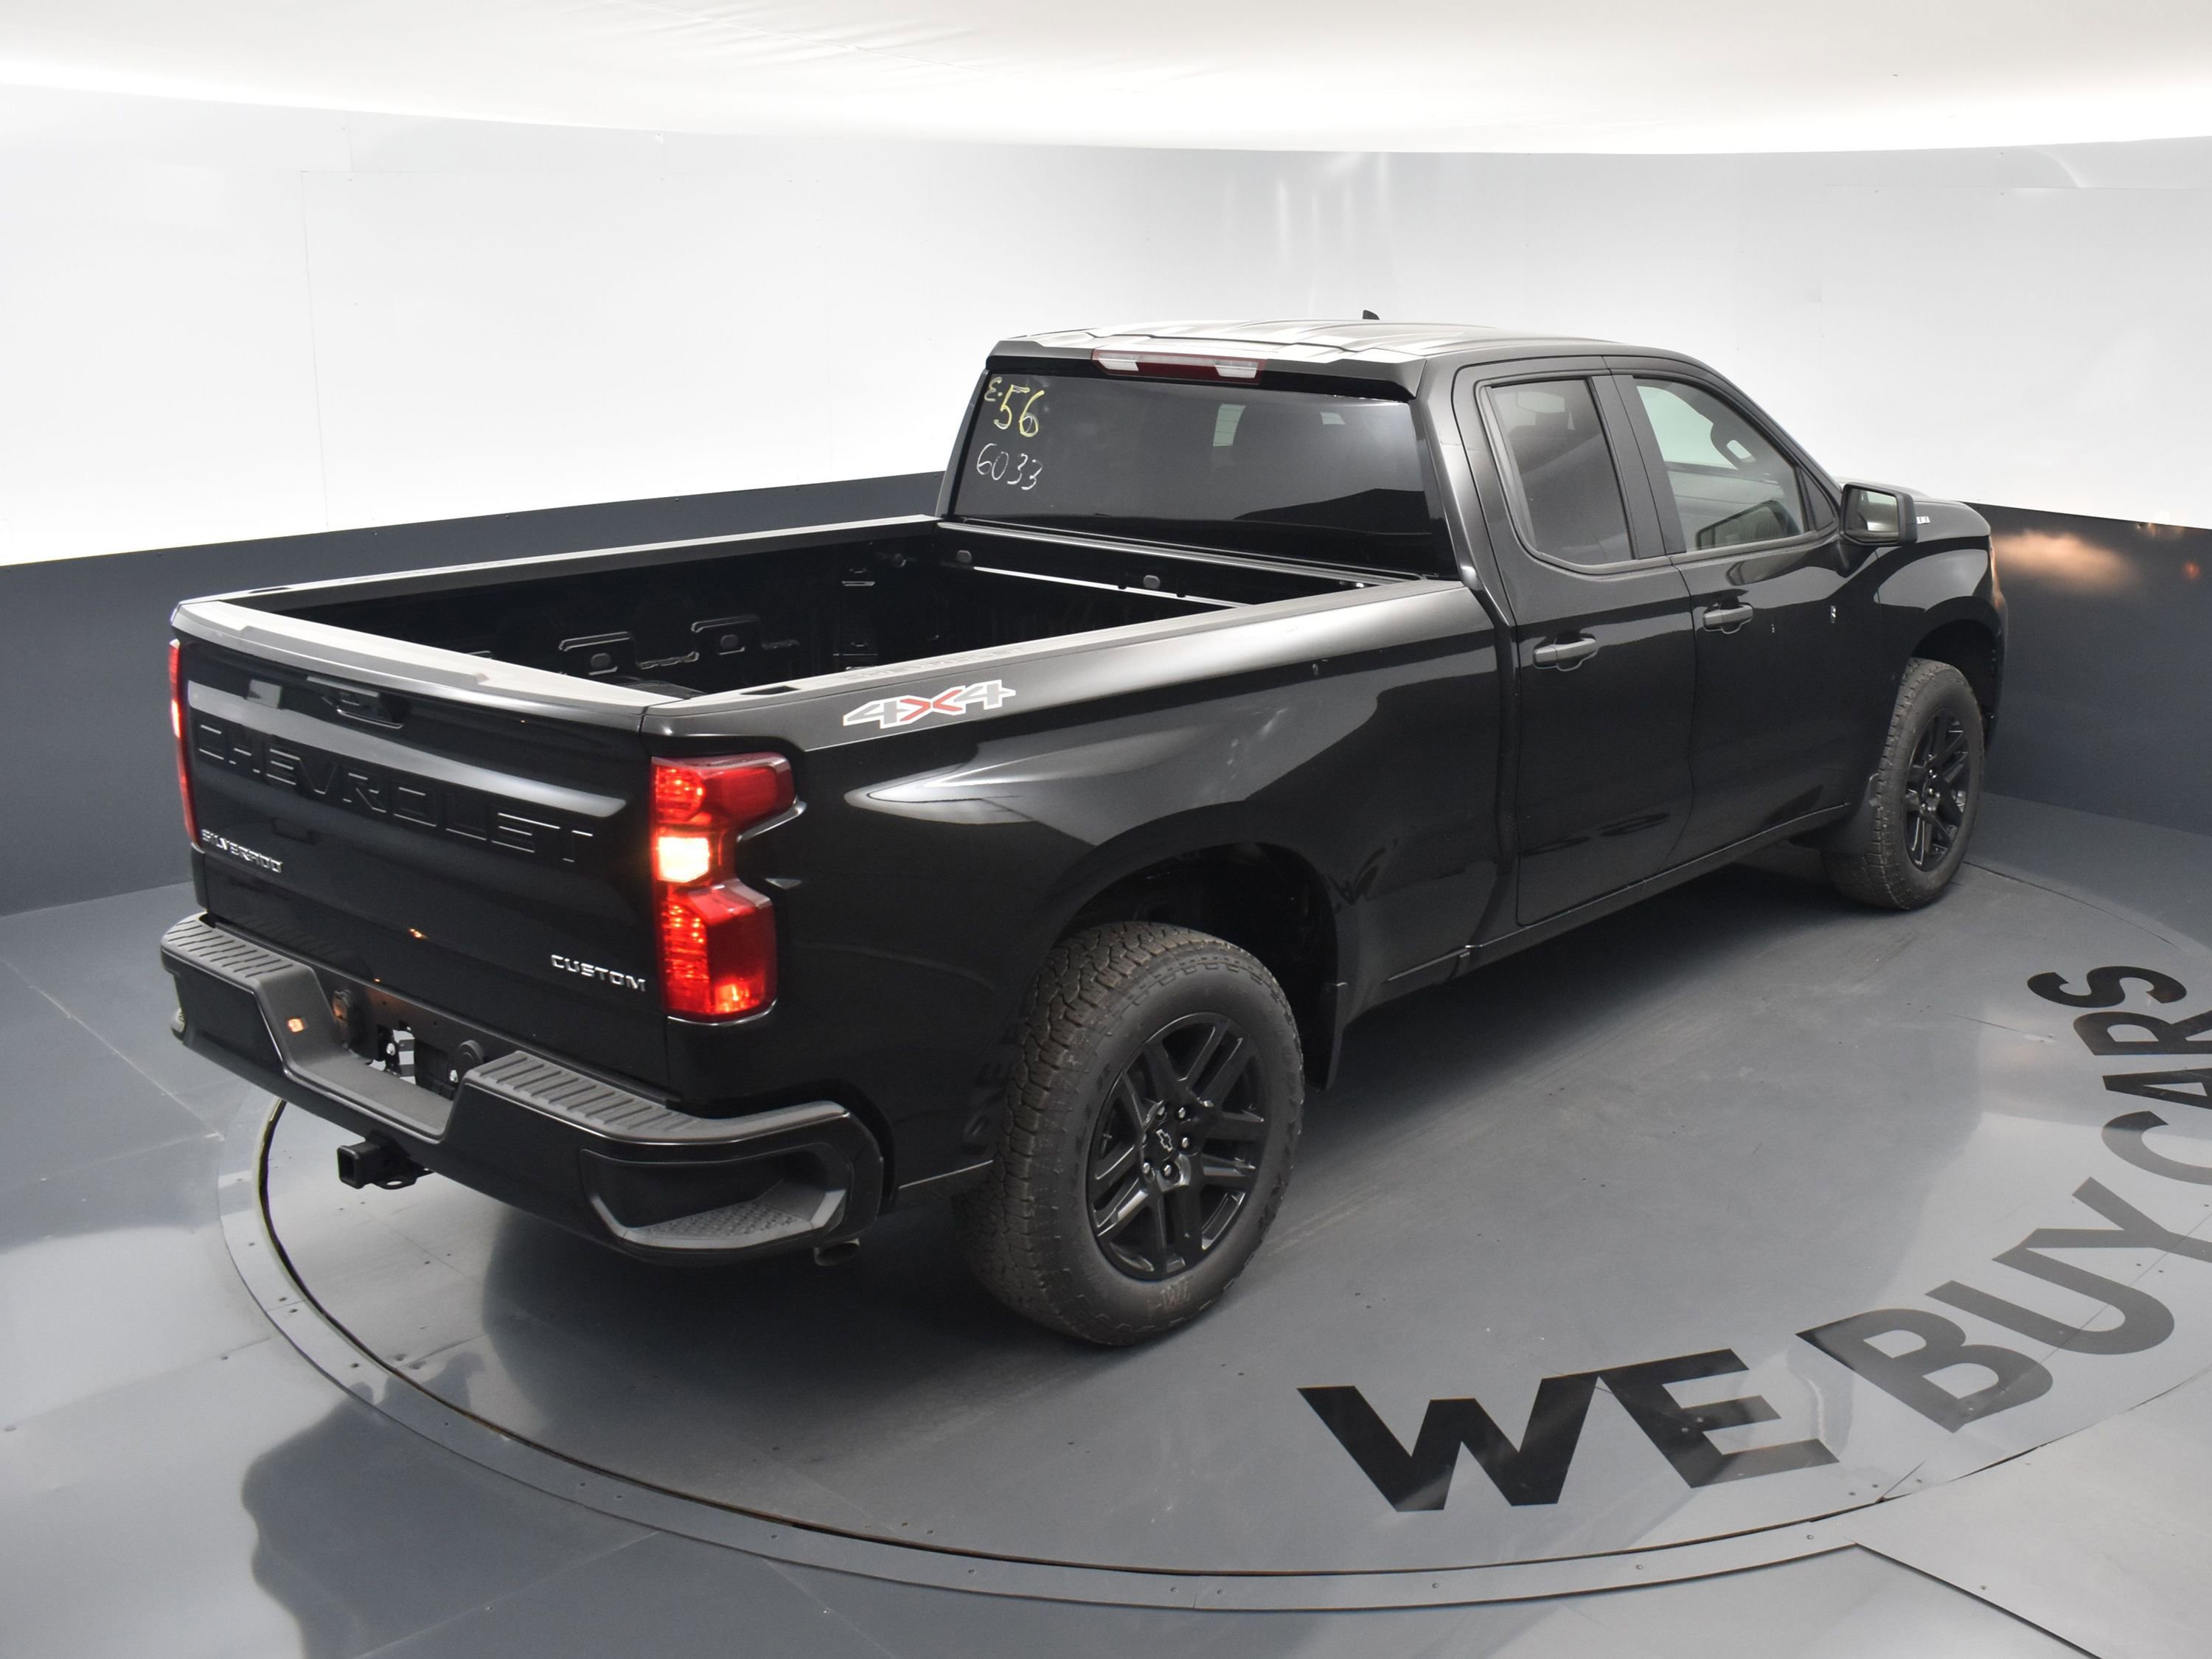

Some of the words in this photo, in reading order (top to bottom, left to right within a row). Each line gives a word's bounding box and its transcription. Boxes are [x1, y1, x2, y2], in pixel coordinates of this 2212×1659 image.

[977, 443, 1043, 490] 6033
[195, 720, 594, 863] CHEVROLET
[201, 829, 283, 873] SILVERADO
[551, 954, 646, 992] CUSTOM
[1297, 1349, 1839, 1512] WE
[1795, 1176, 2212, 1433] BUY
[2027, 965, 2212, 1186] CARS
